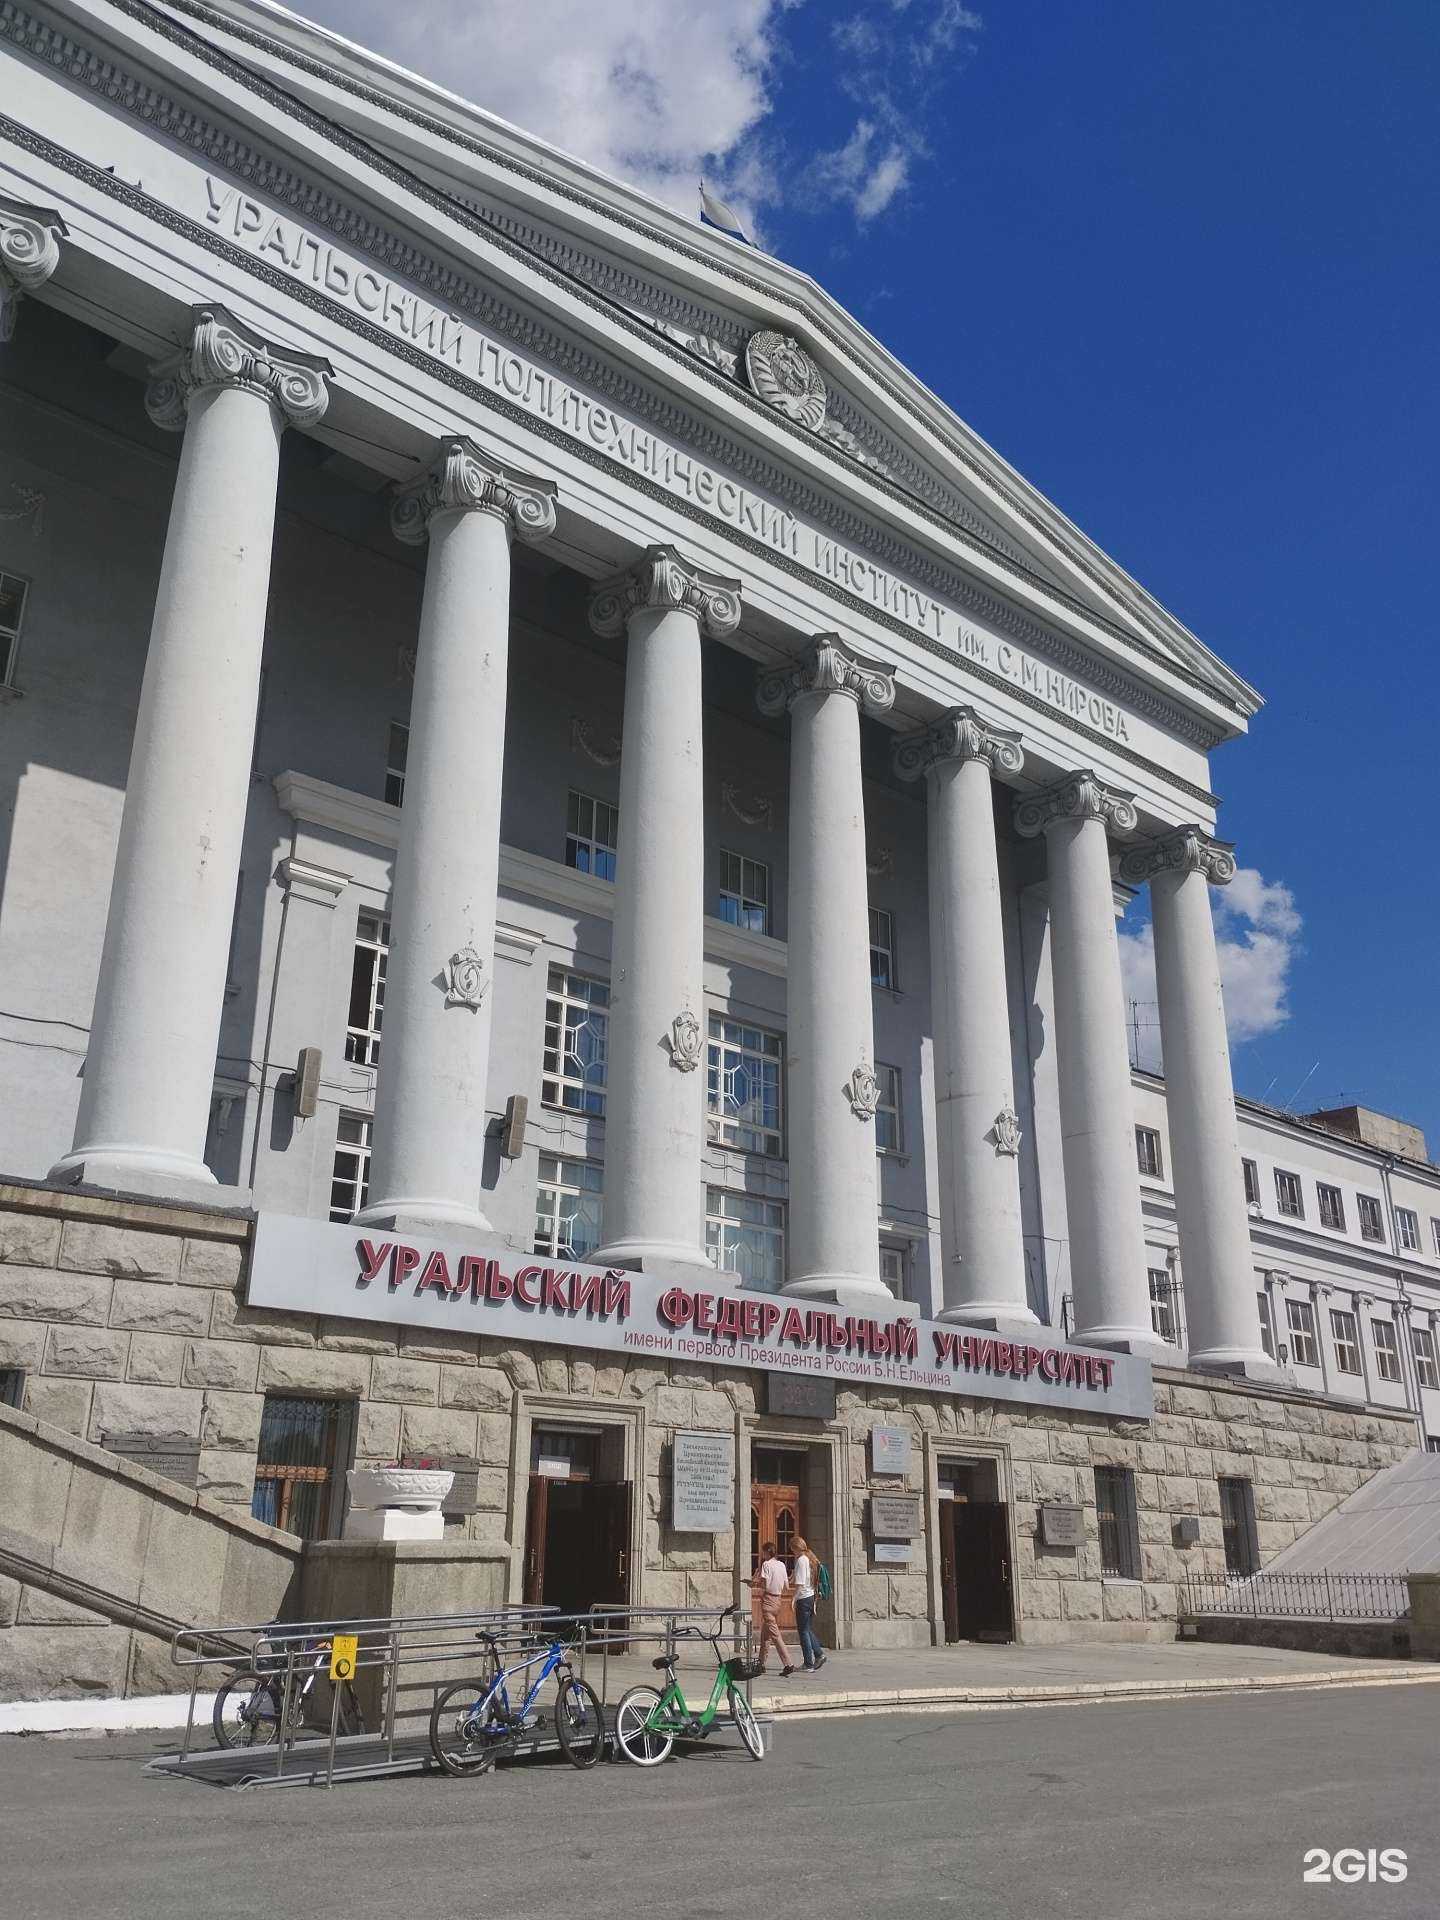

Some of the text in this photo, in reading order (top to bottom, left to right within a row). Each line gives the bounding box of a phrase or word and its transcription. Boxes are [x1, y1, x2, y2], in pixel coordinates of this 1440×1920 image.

[205, 176, 462, 363] УРАЛЬСКИЙ
[814, 535, 944, 637] ИНСТИТУТ
[358, 1238, 1115, 1388] УРАЛЬСКИЙ ФЕДЕРАЛЬНЫЙ УНИВЕРСИТЕТ
[623, 1331, 674, 1350] имени
[678, 1338, 736, 1359] первого
[739, 1343, 821, 1369] Президента
[826, 1354, 871, 1376] России
